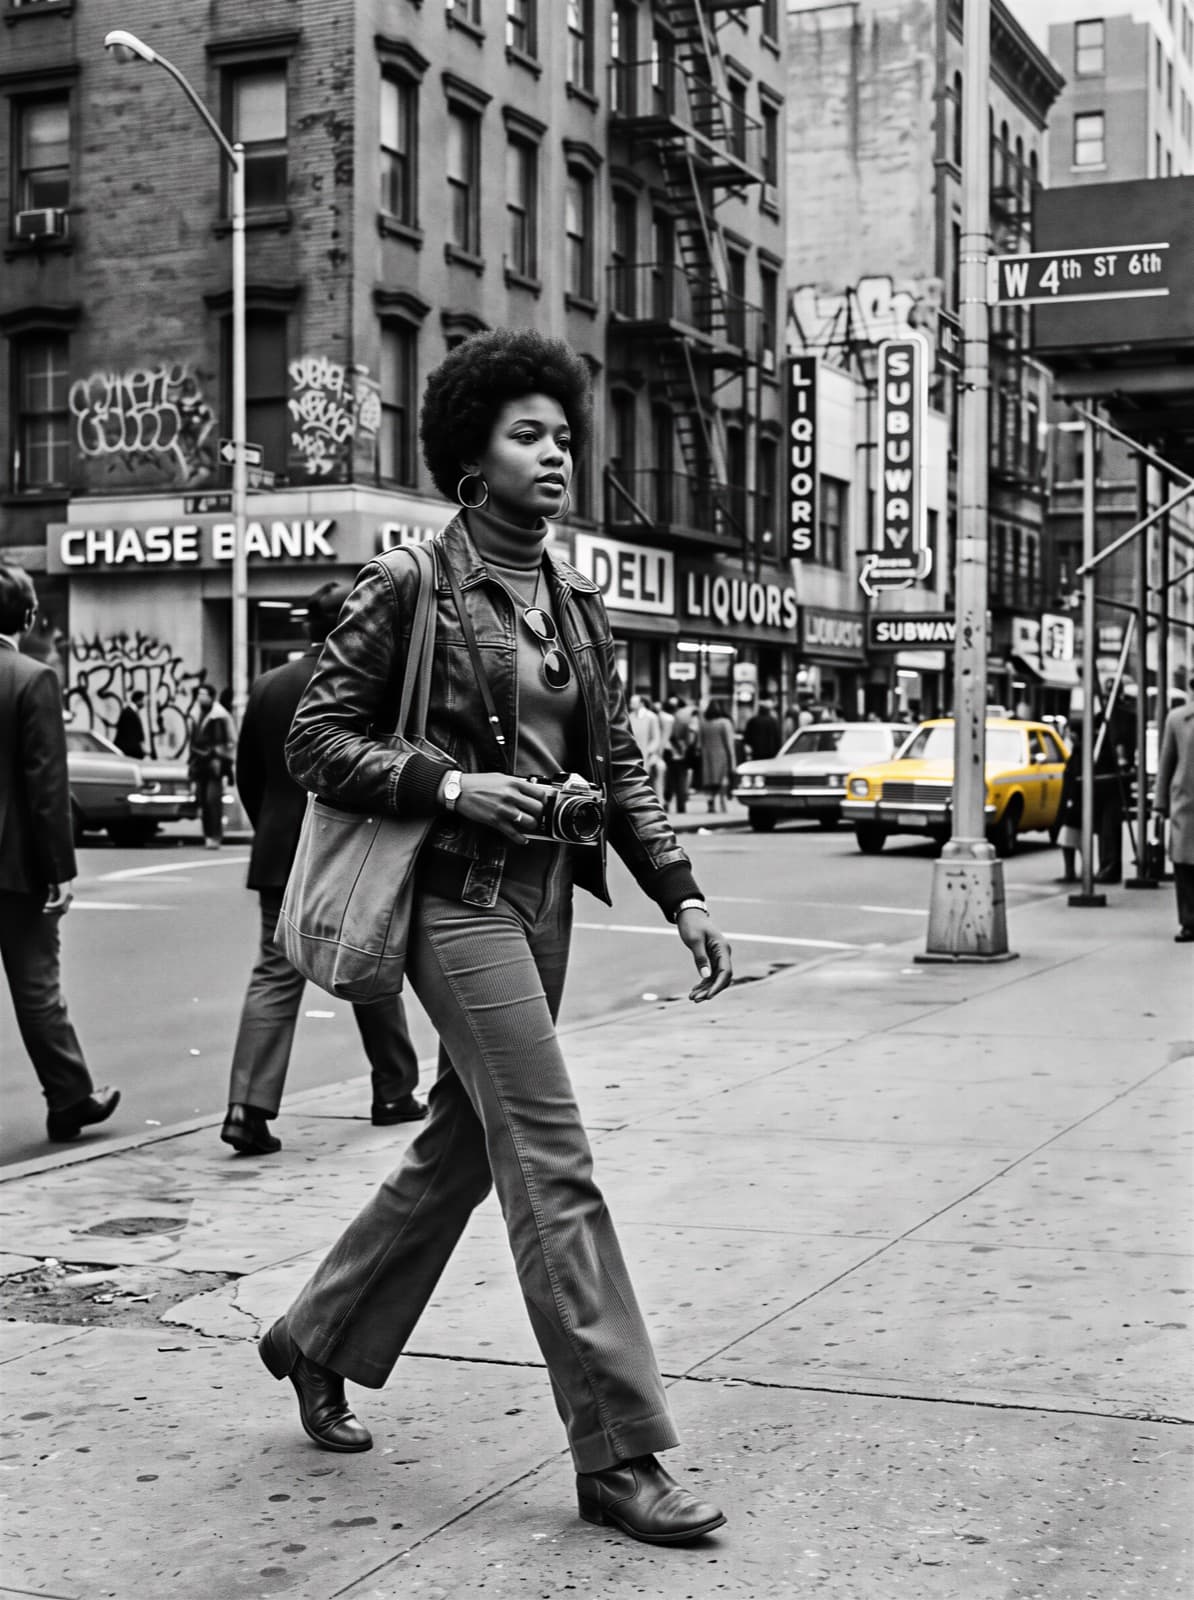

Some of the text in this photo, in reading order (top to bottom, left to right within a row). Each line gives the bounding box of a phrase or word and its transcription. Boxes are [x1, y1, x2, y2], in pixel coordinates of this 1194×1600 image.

[1003, 252, 1162, 298] W 4th ST 6th
[790, 363, 813, 551] LIQUORS
[885, 352, 912, 549] SUBUWAY
[60, 518, 336, 565] CHASE BANK
[592, 546, 666, 604] DELI
[687, 570, 799, 629] LIQUORS
[876, 621, 957, 642] SUBWAY
